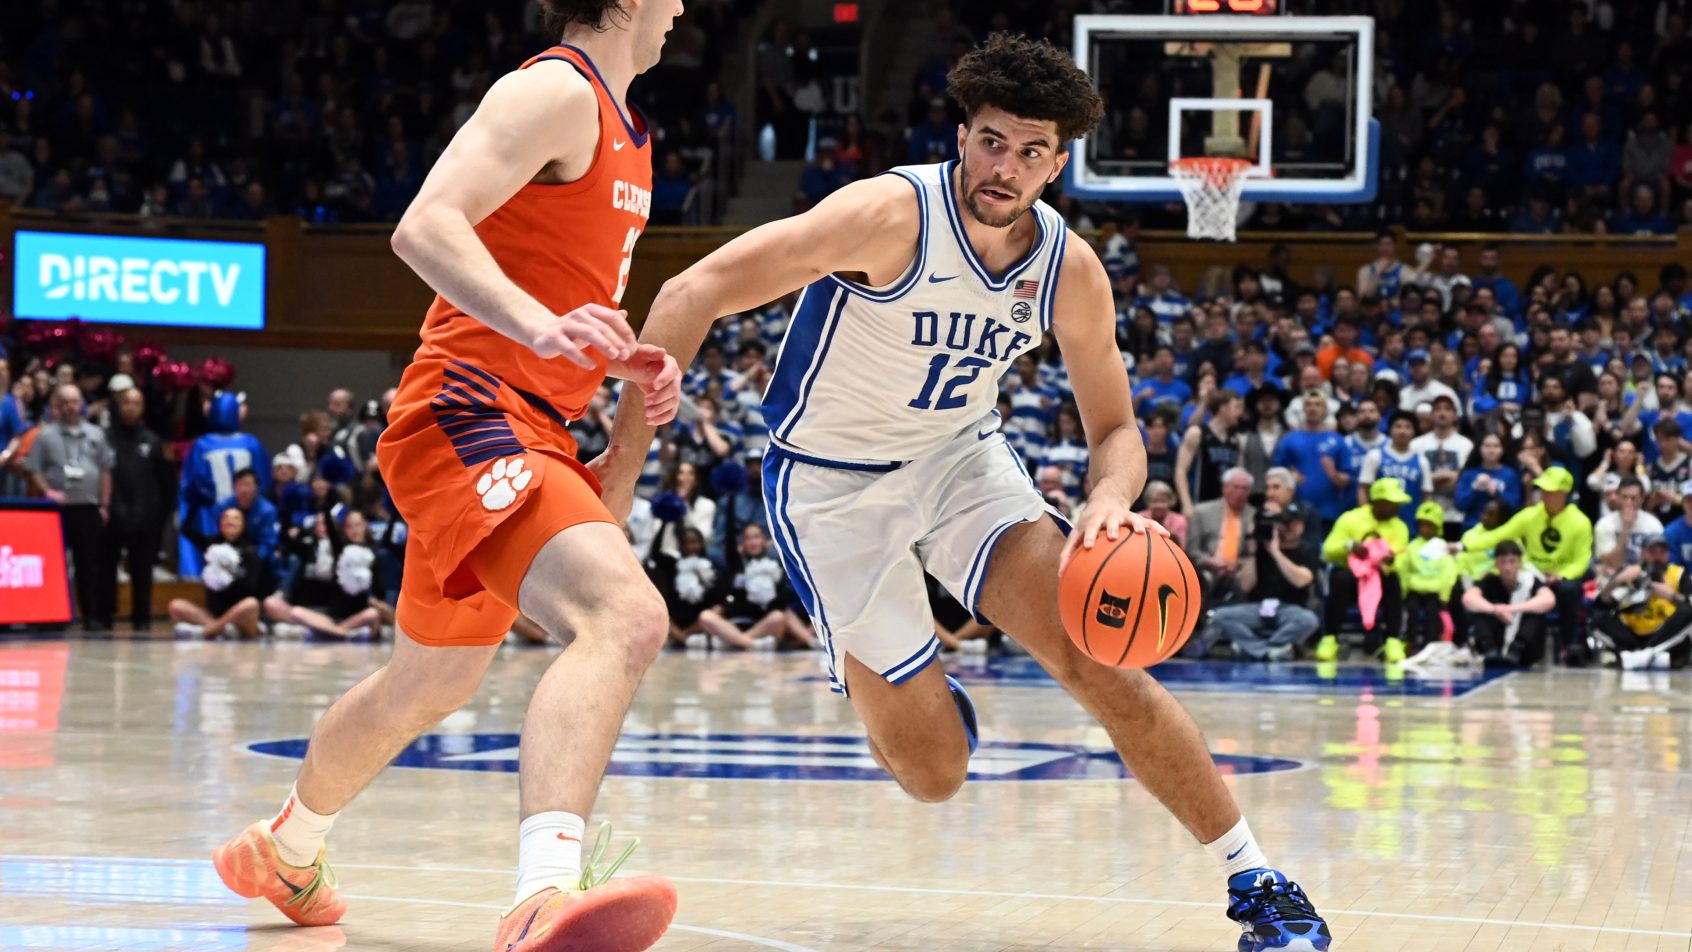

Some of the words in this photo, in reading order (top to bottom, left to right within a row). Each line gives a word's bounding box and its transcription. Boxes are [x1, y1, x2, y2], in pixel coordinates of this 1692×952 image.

[39, 253, 241, 307] DIRECTV
[912, 311, 1032, 361] DUKE
[907, 353, 992, 410] 12
